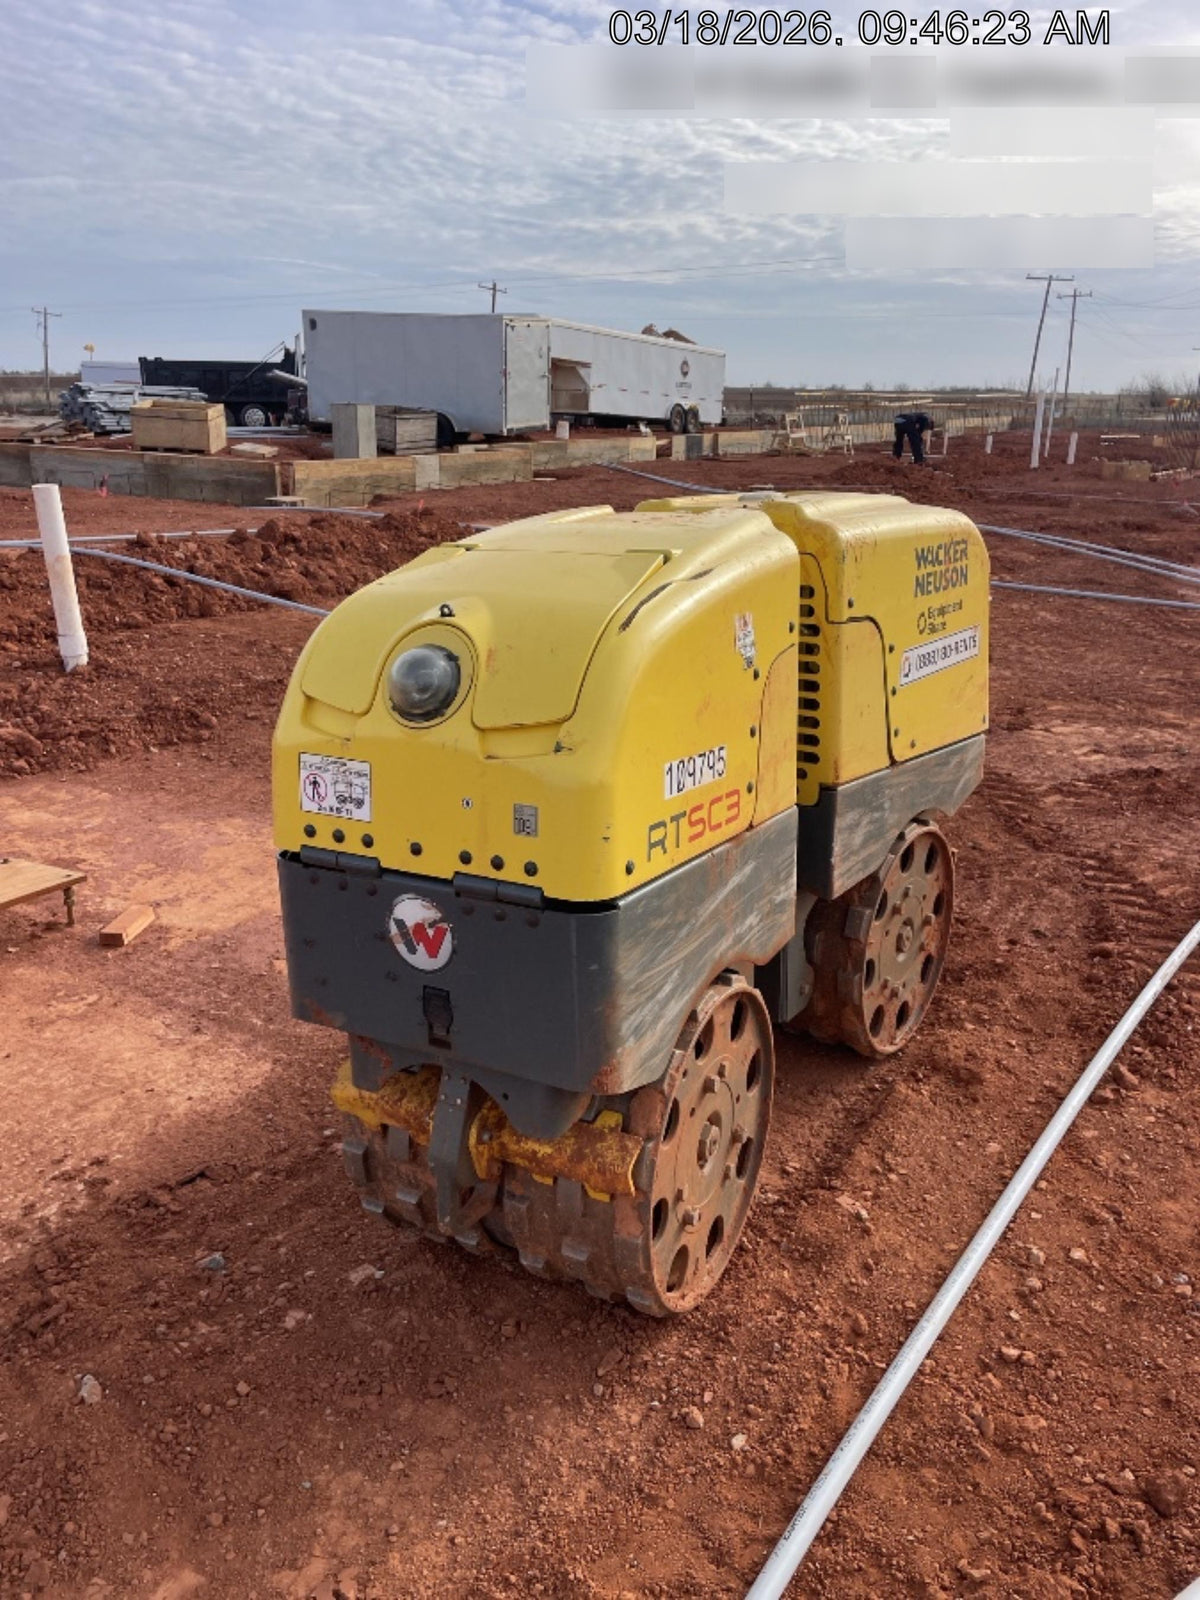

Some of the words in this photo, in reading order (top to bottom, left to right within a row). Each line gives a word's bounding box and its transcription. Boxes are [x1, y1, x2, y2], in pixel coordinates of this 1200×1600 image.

[914, 538, 968, 570] WACKER
[914, 565, 968, 597] NEUSON
[666, 746, 726, 795] 109795
